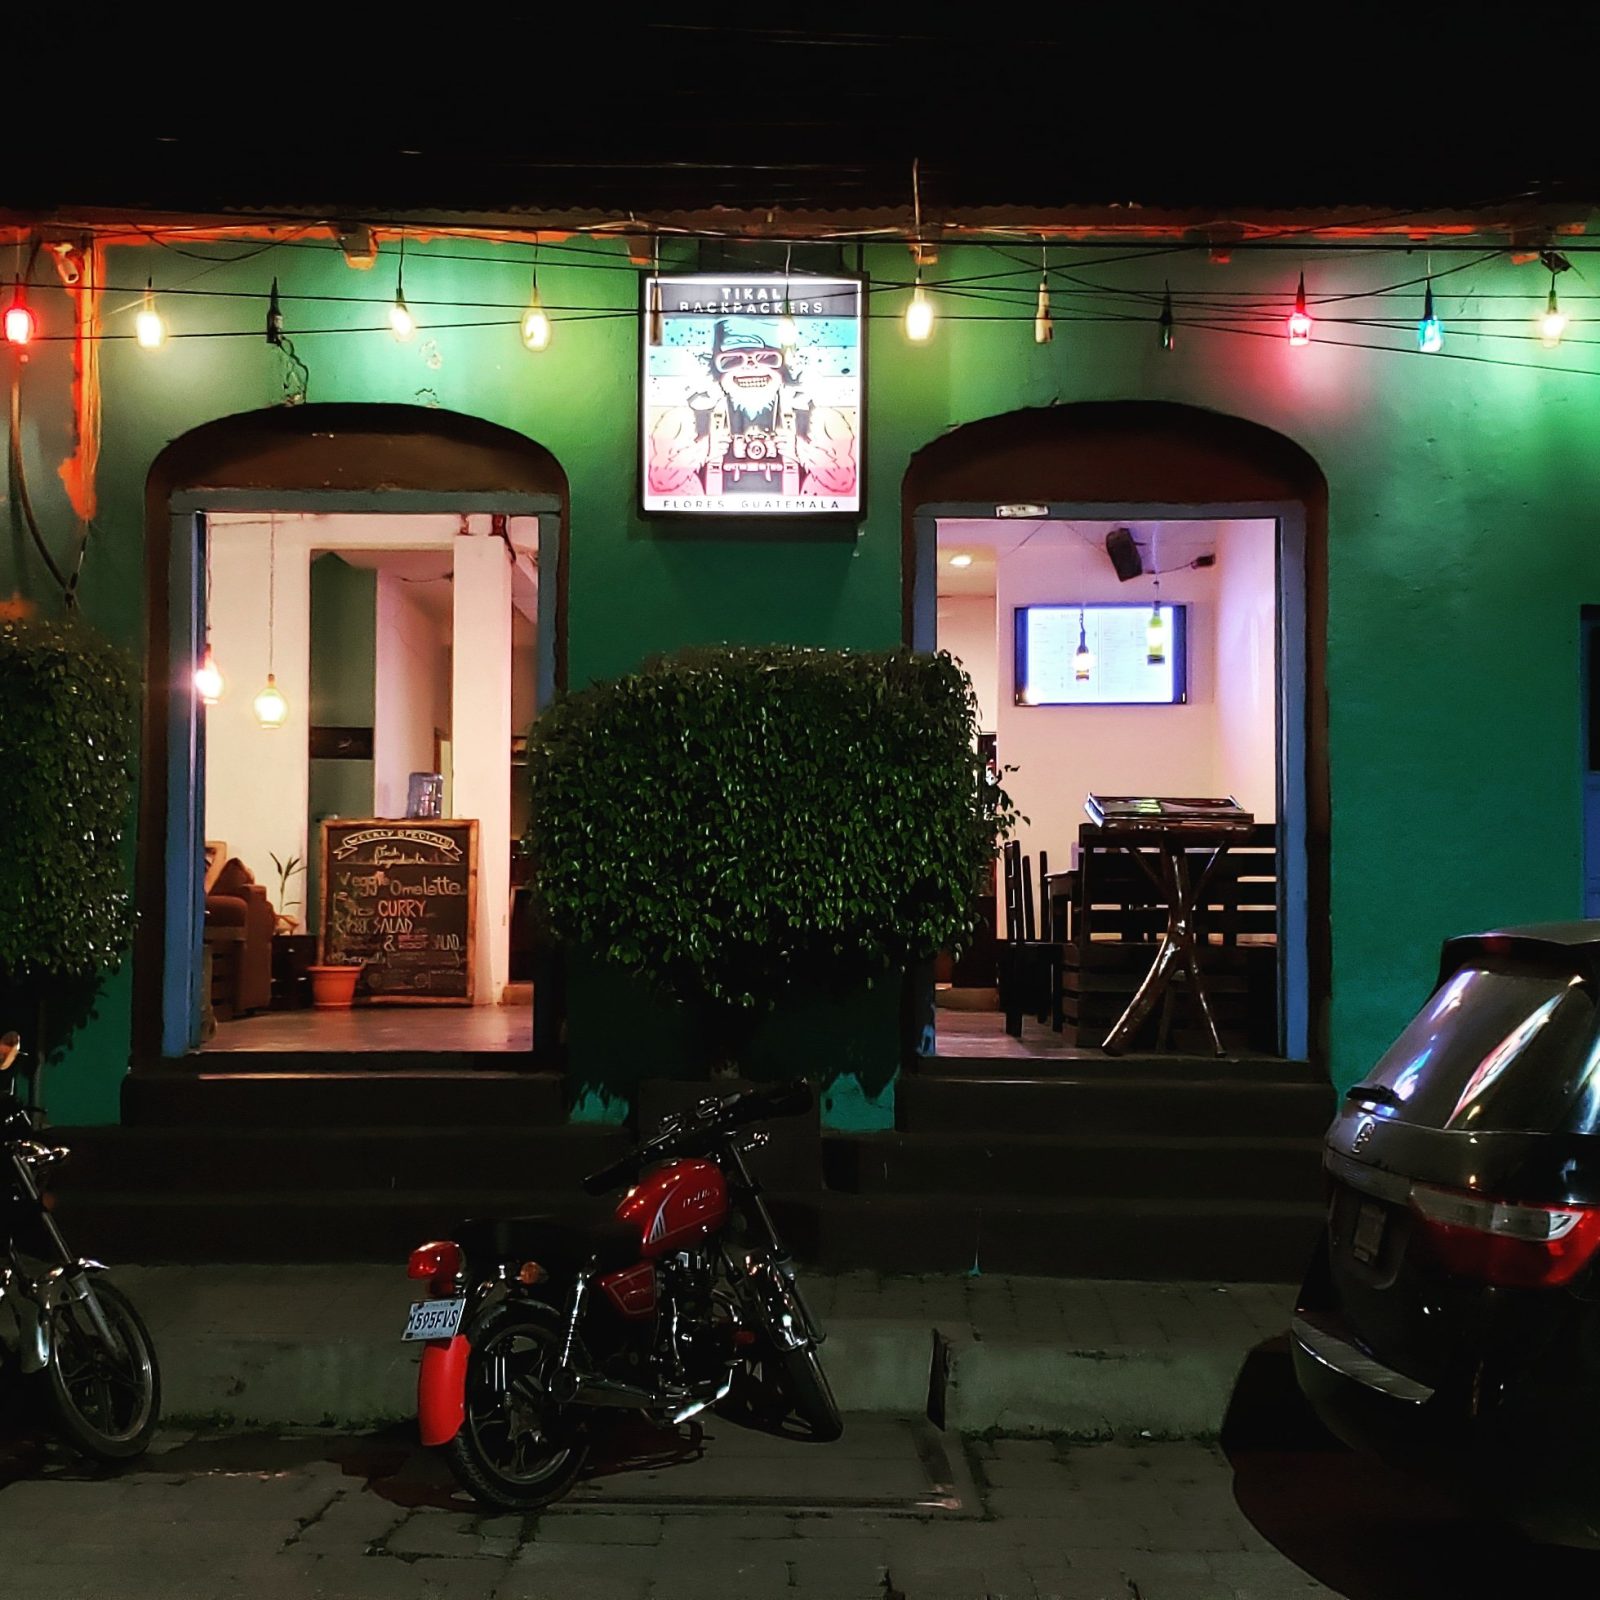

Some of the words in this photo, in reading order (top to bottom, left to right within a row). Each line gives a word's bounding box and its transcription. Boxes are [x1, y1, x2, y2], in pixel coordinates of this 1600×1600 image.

[721, 288, 780, 300] TIKAL
[679, 301, 823, 314] BACKPACKERS
[663, 500, 725, 508] FLORES
[741, 500, 839, 509] GUATEMALA
[390, 876, 461, 897] Omelette
[378, 899, 427, 918] CURRY
[373, 917, 414, 934] SALAD
